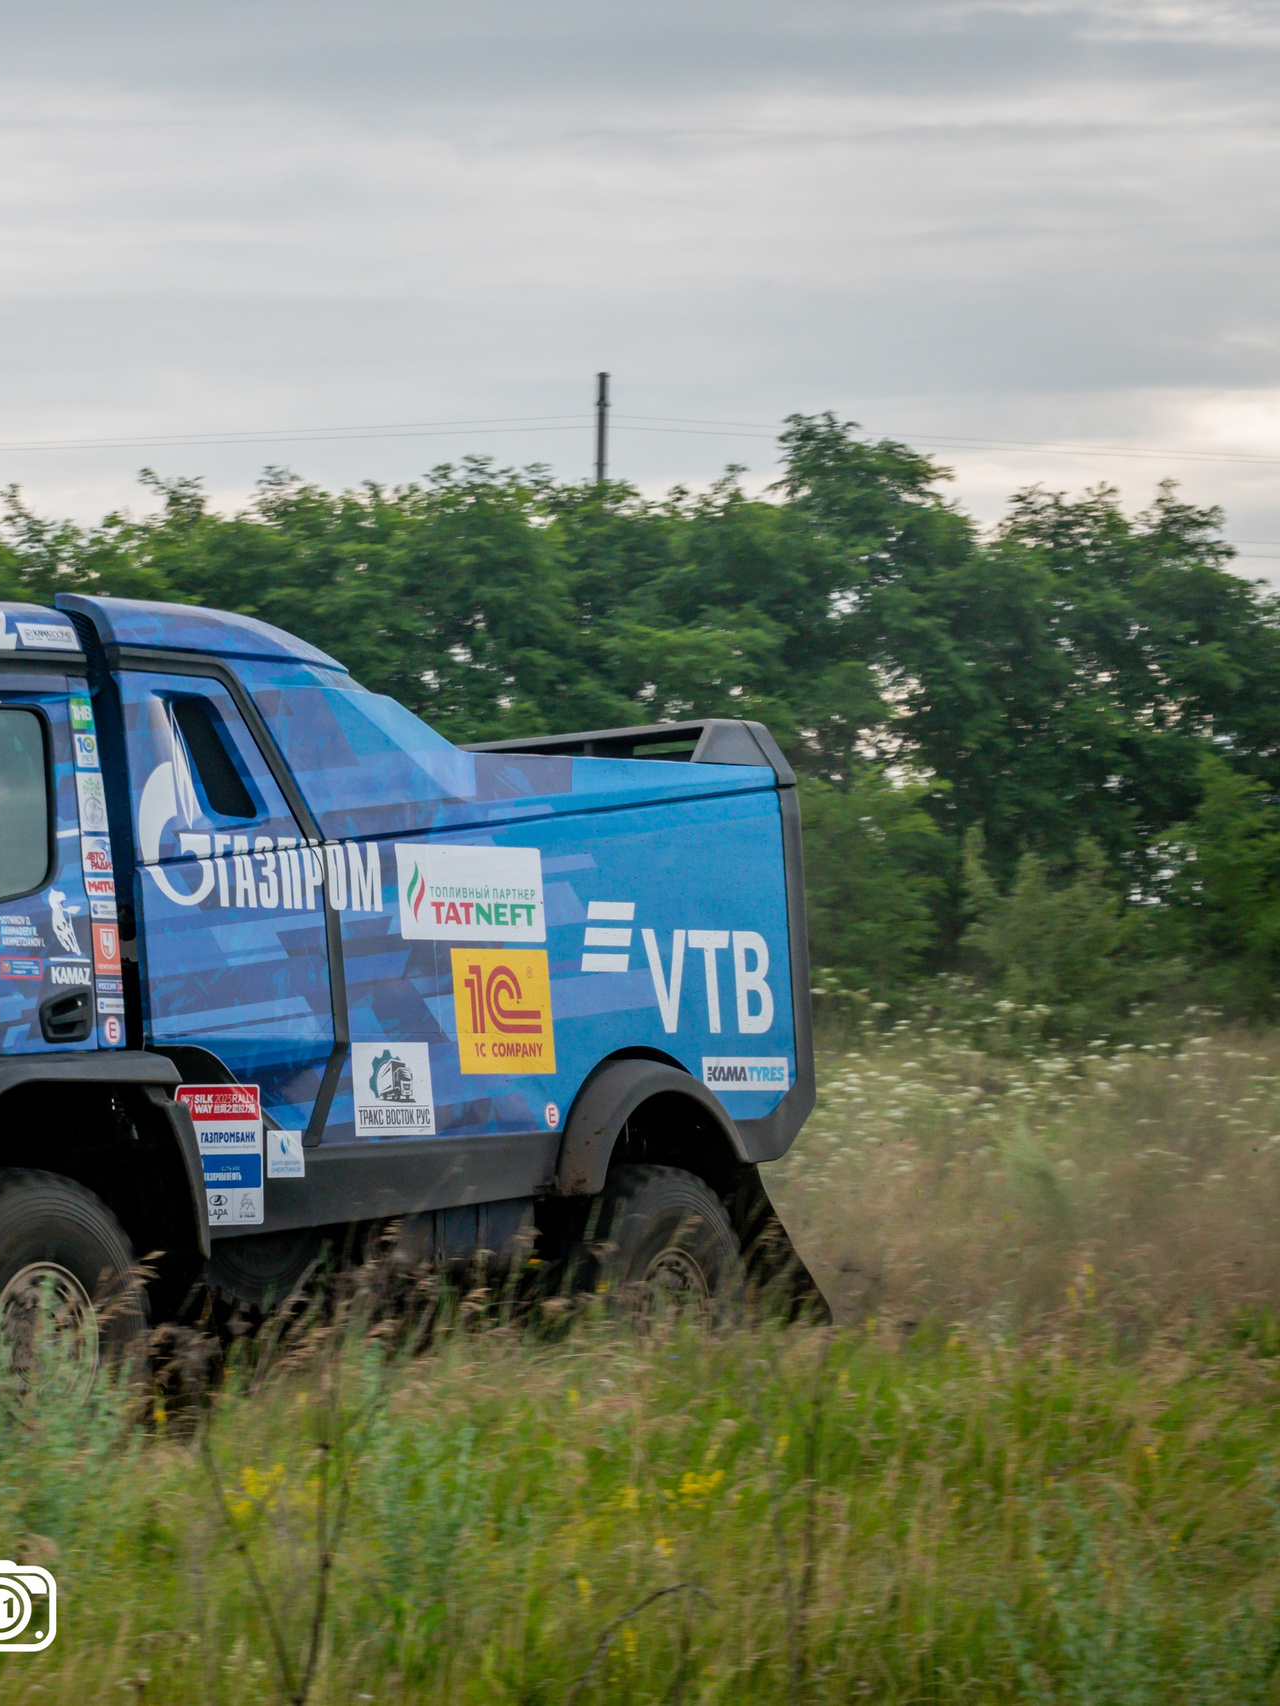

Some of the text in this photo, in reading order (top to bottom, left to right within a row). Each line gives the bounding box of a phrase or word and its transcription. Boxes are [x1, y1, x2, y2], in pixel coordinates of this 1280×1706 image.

[77, 736, 95, 754] 10
[85, 851, 106, 861] АВТО
[91, 860, 113, 870] РАДИ
[214, 833, 384, 912] ГАЗПРОМ
[87, 880, 115, 893] МАТЧ
[429, 885, 536, 900] ТОПЛИВНЫЙ ПАРТНЕР
[431, 902, 537, 926] TATNEFT
[50, 966, 92, 985] KAMAZ
[641, 928, 775, 1034] VTB
[108, 1021, 117, 1039] E
[492, 1042, 543, 1058] COMPANY
[194, 1093, 255, 1104] SILK 2023 RALLY
[194, 1103, 213, 1114] WAY
[548, 1108, 557, 1124] E
[358, 1108, 431, 1126] ТРАКС ВОСТОК РУС
[200, 1131, 256, 1143] ГАЗПРОМБАНК
